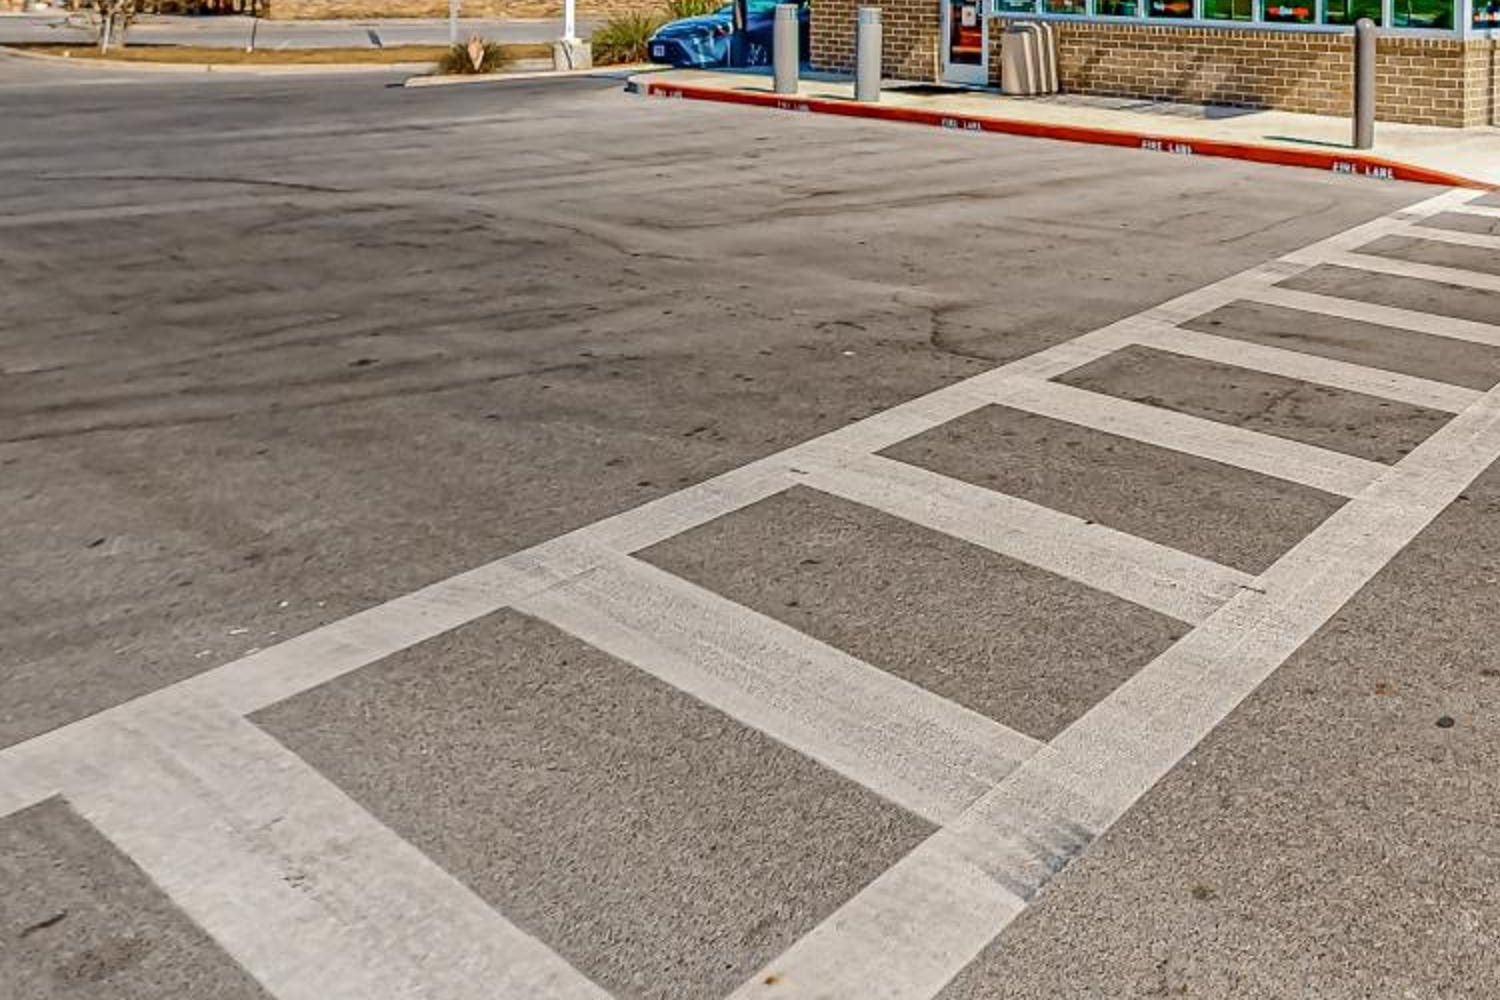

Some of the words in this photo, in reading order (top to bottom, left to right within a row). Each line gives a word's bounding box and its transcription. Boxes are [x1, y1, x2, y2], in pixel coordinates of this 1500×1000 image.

[1141, 139, 1162, 152] FIRE
[1333, 161, 1357, 175] FIRE
[1365, 164, 1394, 180] LANE
